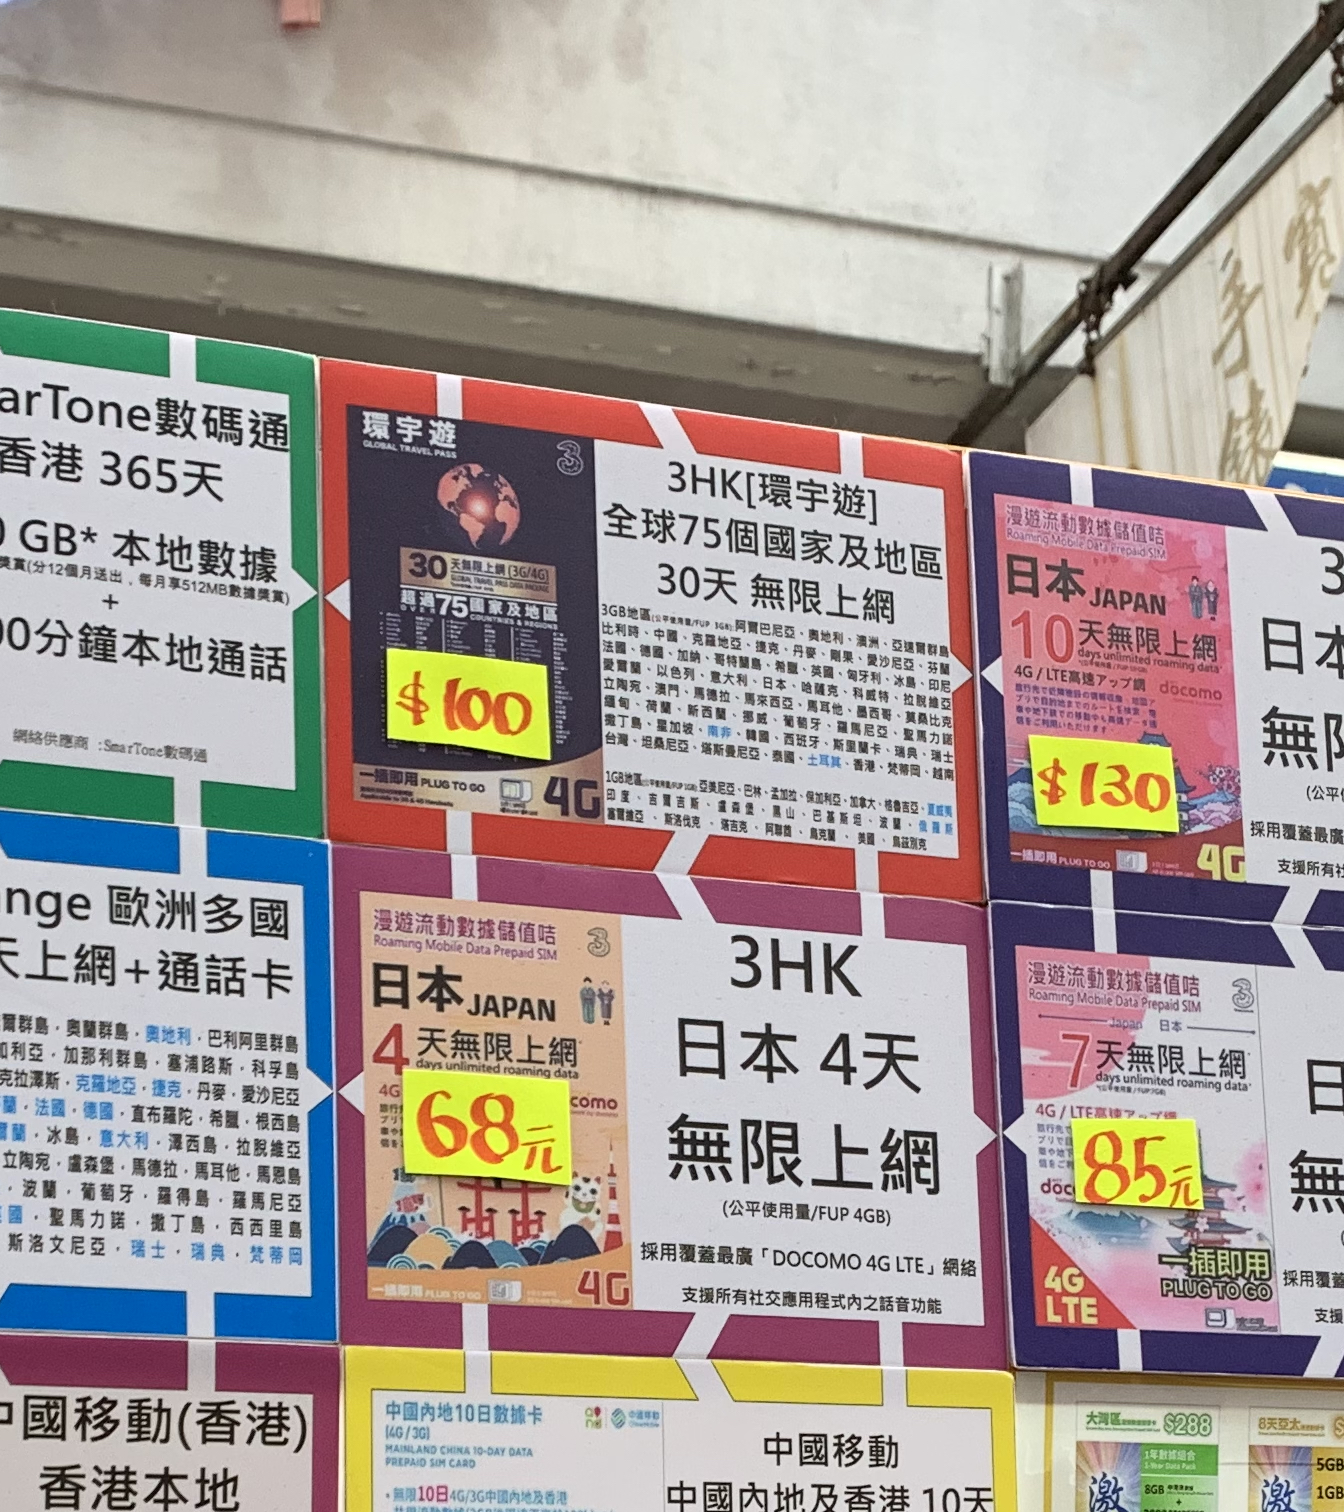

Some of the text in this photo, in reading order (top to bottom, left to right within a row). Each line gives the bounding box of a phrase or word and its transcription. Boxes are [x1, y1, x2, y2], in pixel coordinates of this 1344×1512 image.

[363, 410, 456, 448] 環宇遊
[98, 455, 225, 502] 365天
[667, 459, 877, 524] 3HK[環宇遊]
[603, 502, 943, 580] 全球75個國家及地區
[657, 563, 895, 626] 30天 無限上網
[1006, 553, 1166, 617] 日本 JAPAN
[108, 884, 289, 941] 歐洲多國
[373, 907, 557, 947] 漫遊流動數據儲值咭
[372, 962, 556, 1023] 日本 JAPAN
[729, 934, 862, 998] 3HK
[677, 1016, 921, 1094] 日本 4天
[417, 1088, 562, 1174] 68元
[666, 1112, 939, 1196] 無限上網
[1082, 1129, 1201, 1204] 85元
[1044, 1266, 1085, 1294] 4G
[1159, 1246, 1271, 1279] 一插即用
[1044, 1296, 1098, 1325] LTE
[762, 1432, 901, 1471] 中國移動
[1163, 1412, 1213, 1439] $288
